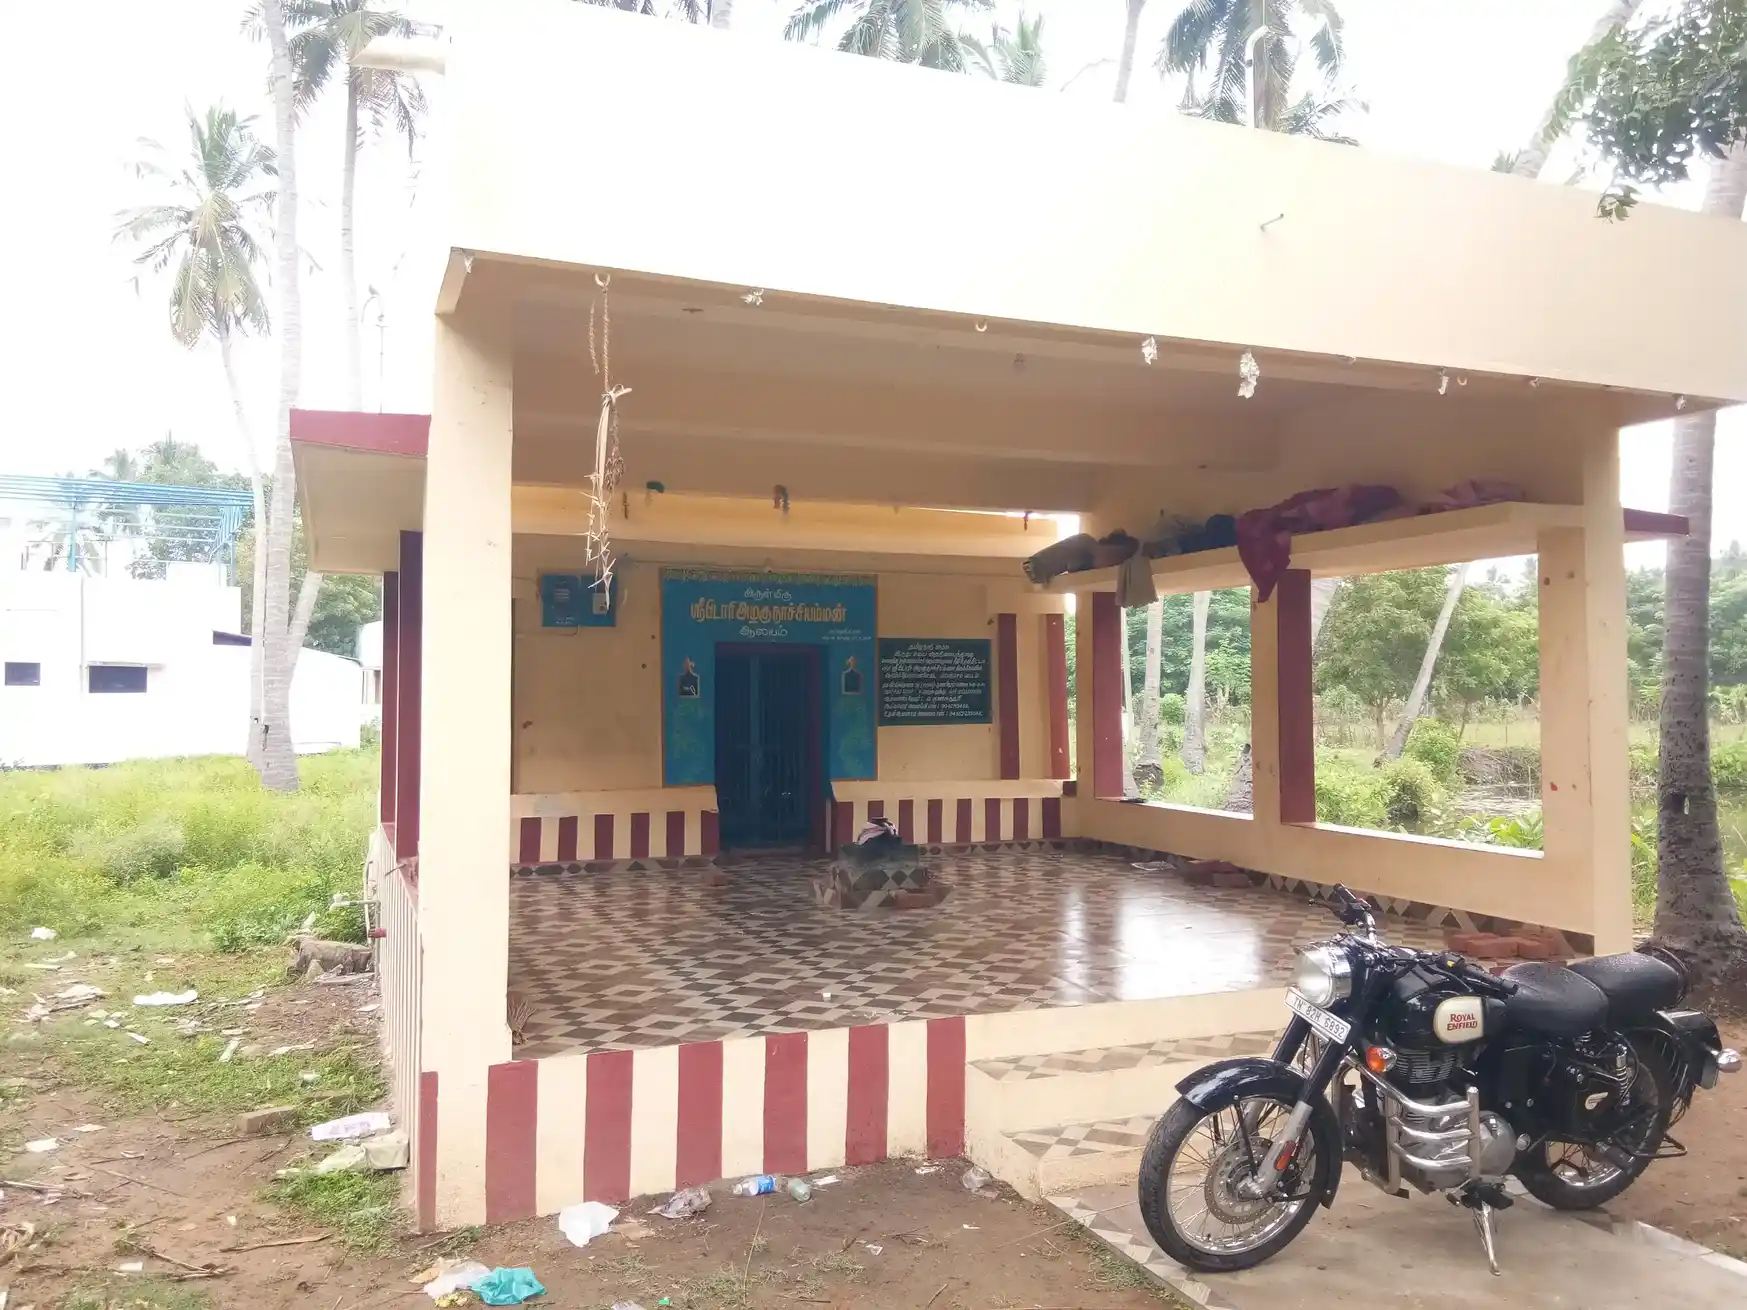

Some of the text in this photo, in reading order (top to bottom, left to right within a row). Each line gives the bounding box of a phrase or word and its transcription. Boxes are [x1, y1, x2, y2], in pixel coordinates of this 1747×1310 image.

[1293, 997, 1345, 1038] TN 82H 6892
[1450, 1013, 1475, 1022] ROYAL
[1447, 1020, 1478, 1031] ENFIELD
